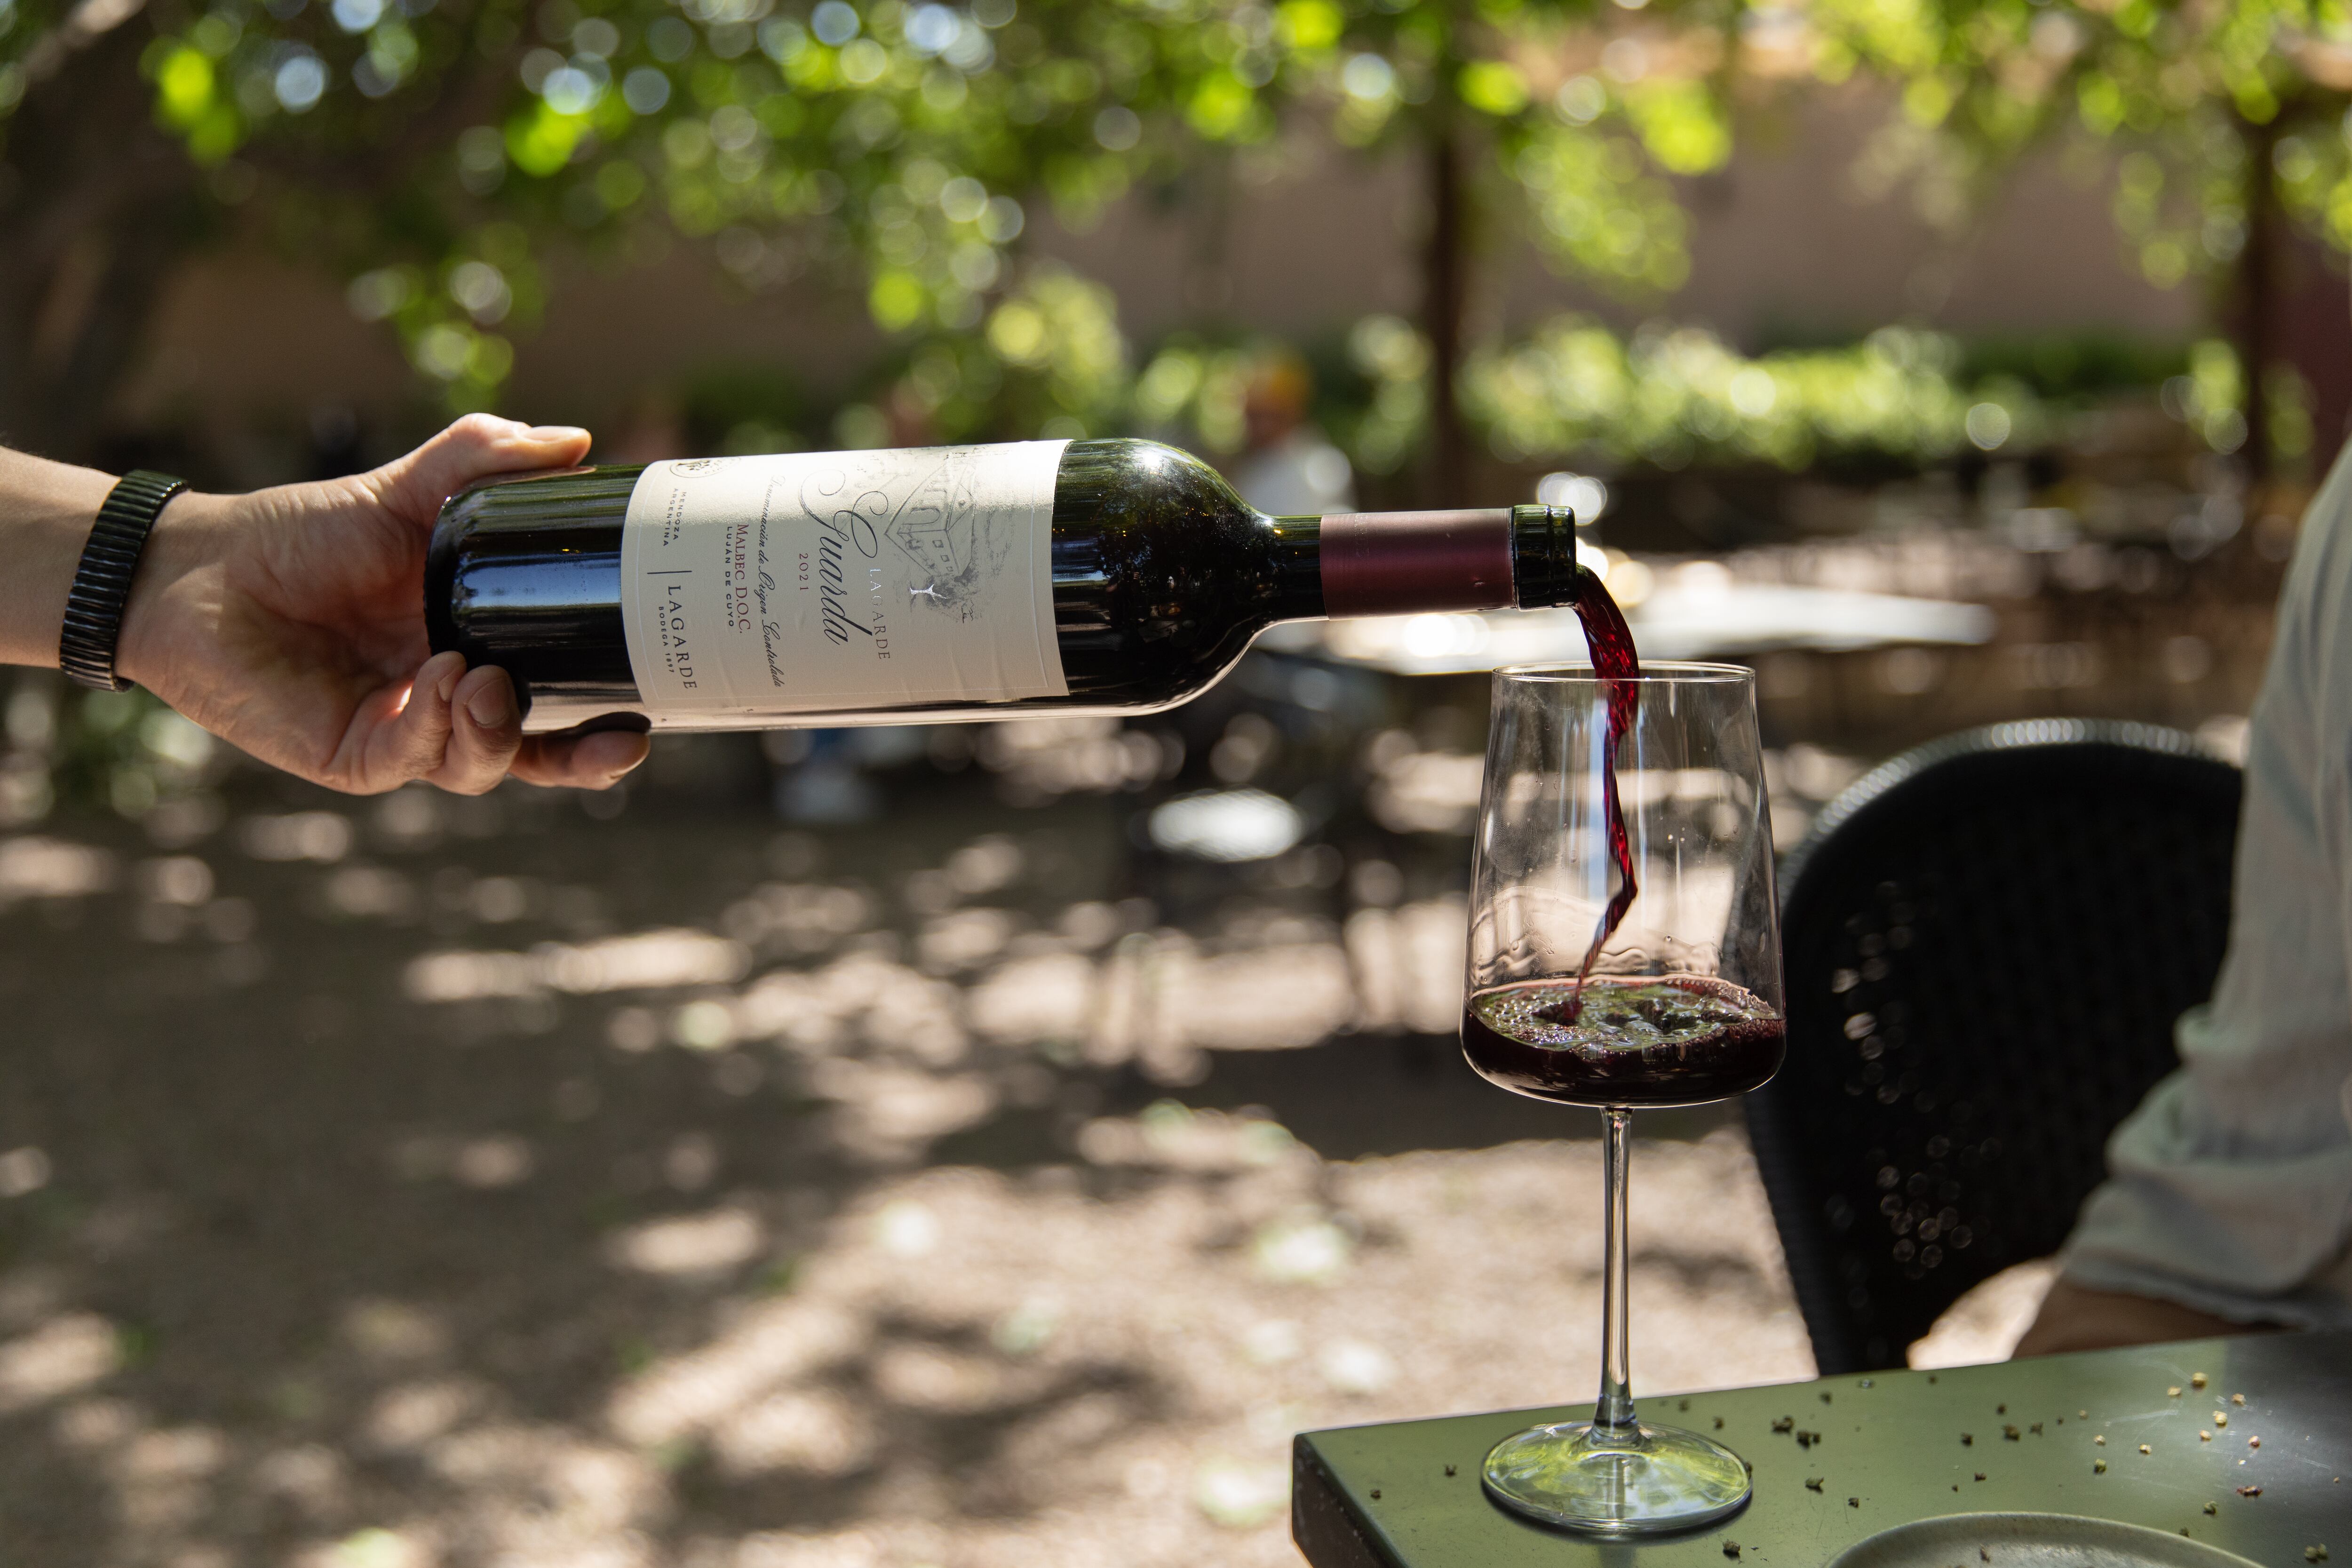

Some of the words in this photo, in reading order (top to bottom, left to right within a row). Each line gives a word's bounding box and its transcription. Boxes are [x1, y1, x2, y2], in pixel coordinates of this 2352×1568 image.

[663, 488, 678, 546] ARGENTINA
[674, 492, 687, 540] MENDOZA
[759, 475, 786, 548] Denominación
[725, 572, 731, 586] DE
[735, 524, 749, 580] MALBEC
[758, 549, 769, 564] de
[799, 469, 888, 645] Guarda
[799, 553, 809, 591] 2021
[726, 594, 734, 627] CUYO
[736, 587, 751, 634] D.O.C.
[754, 565, 775, 614] Origen
[869, 568, 890, 660] LAGARDE
[659, 606, 668, 646] BODEGA
[665, 653, 674, 673] 1897
[668, 585, 697, 689] LAGARDE
[762, 620, 785, 687] Controlada
